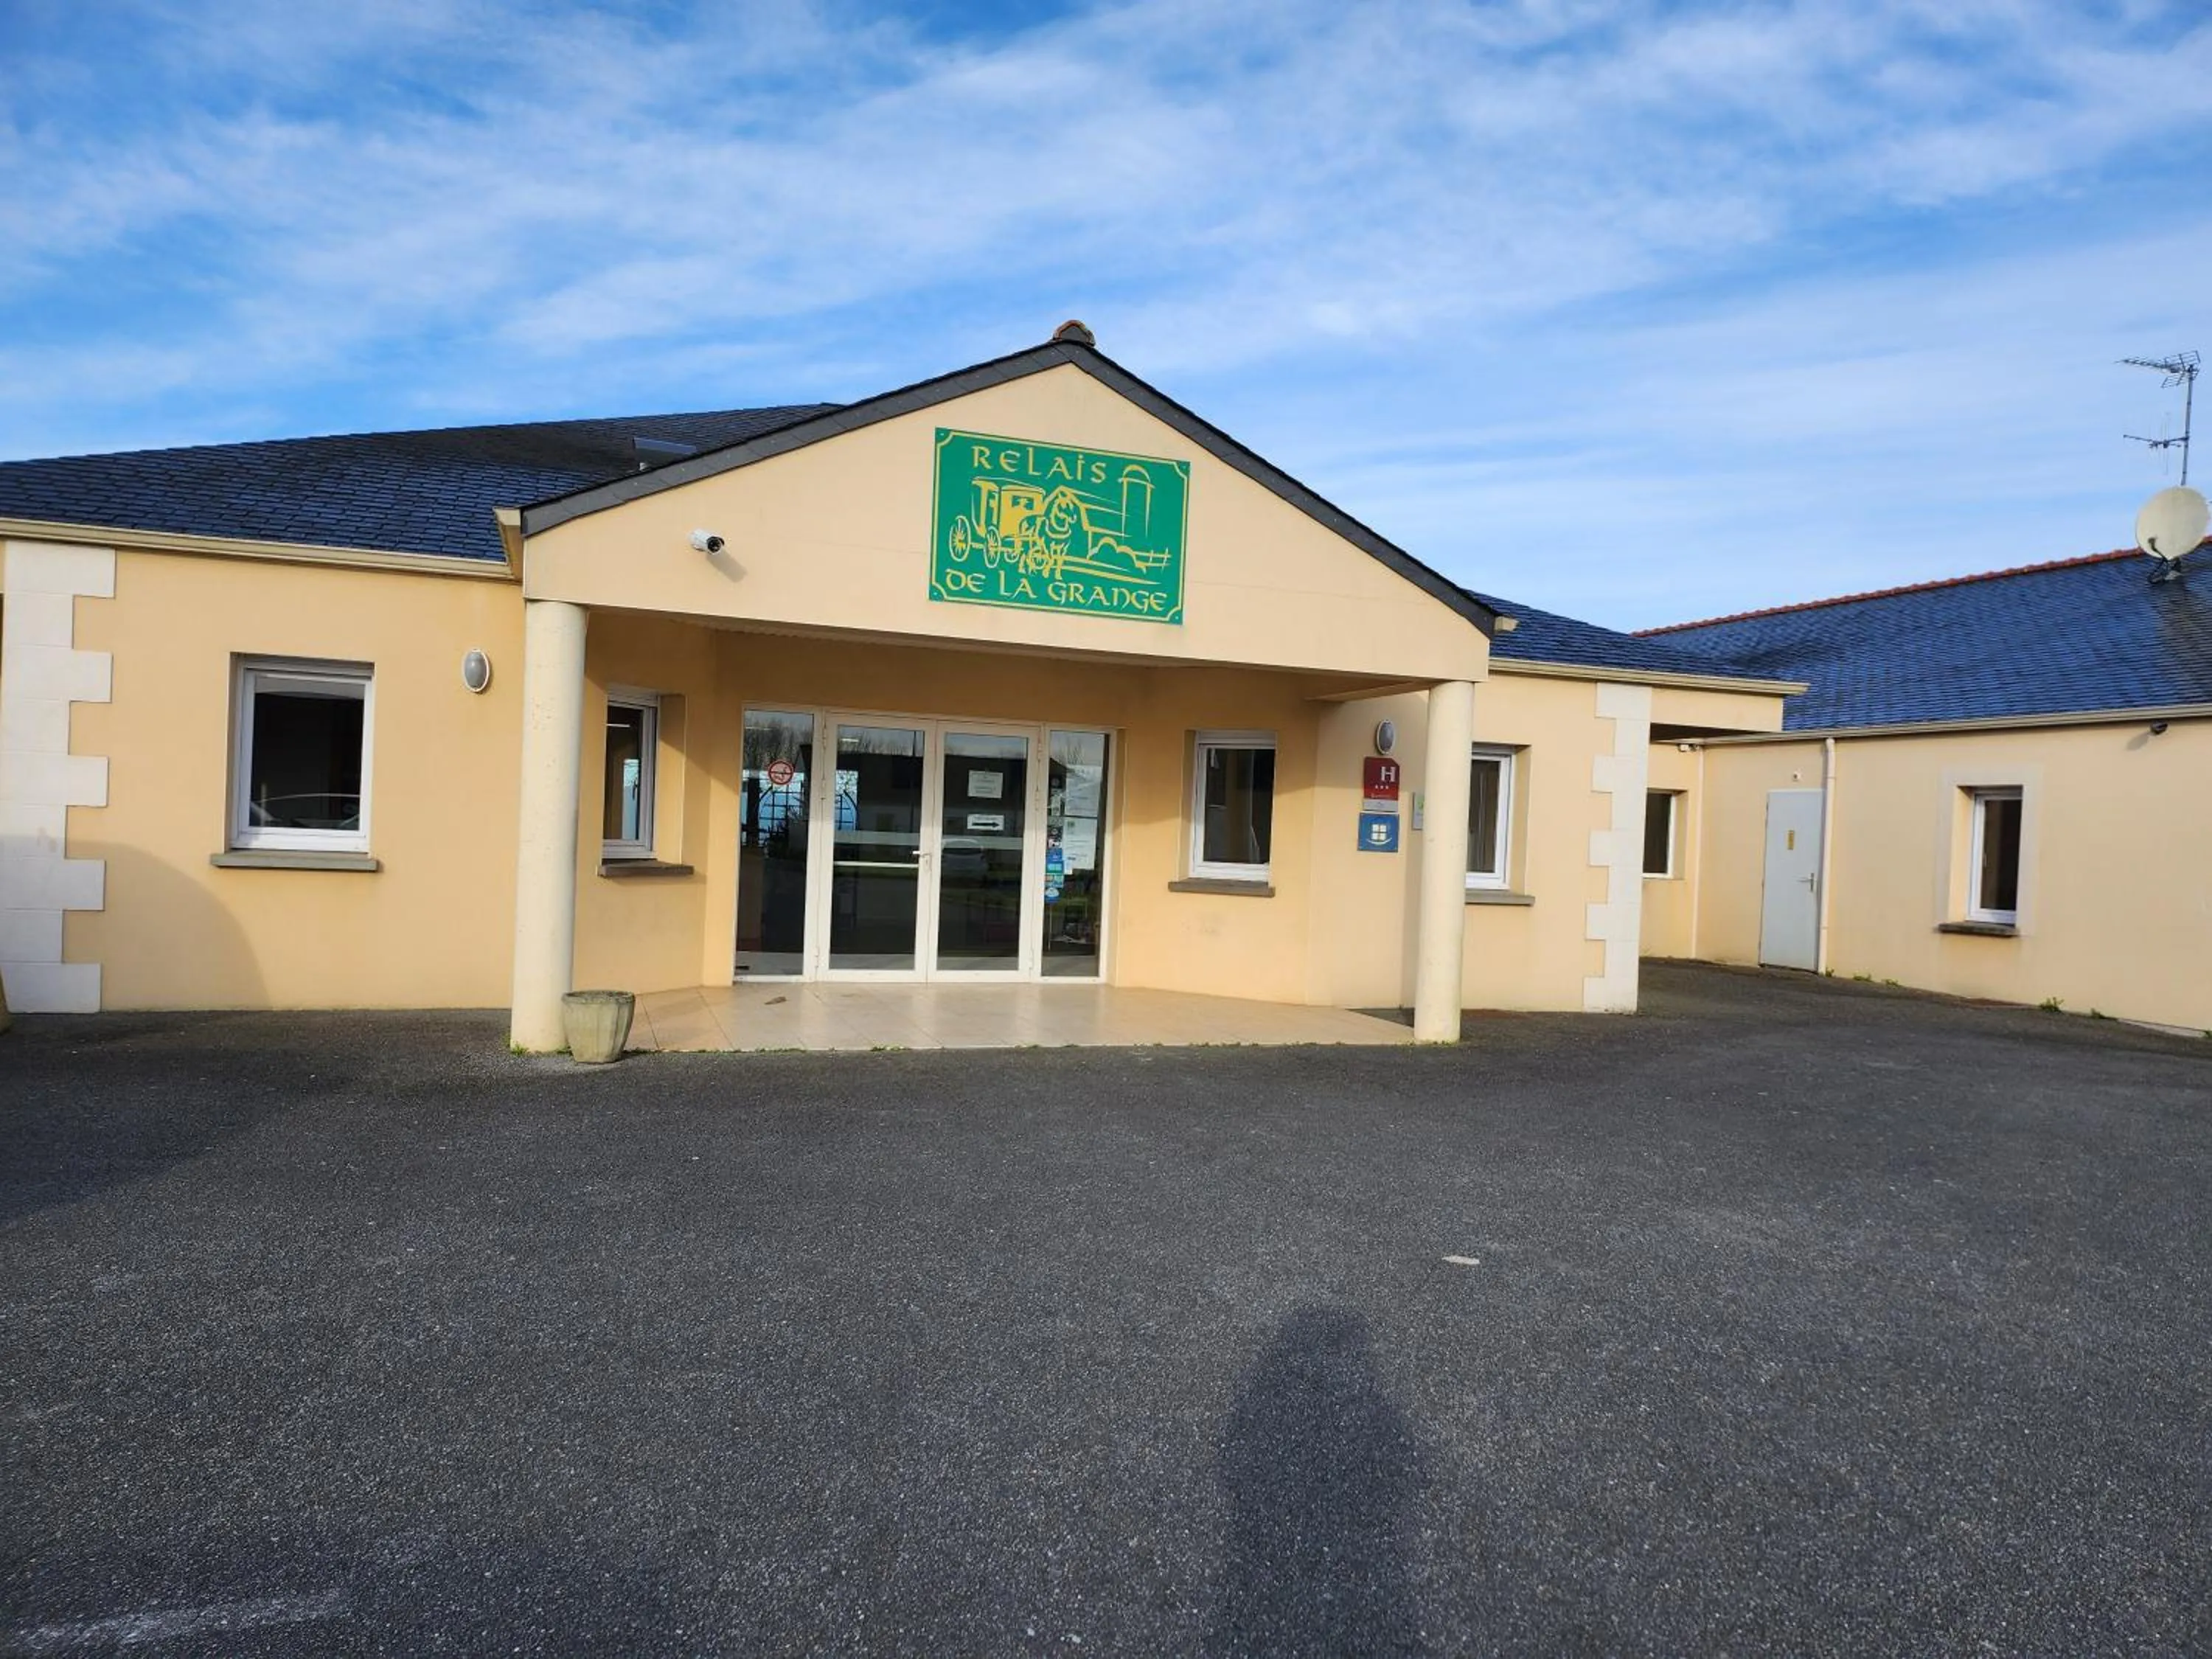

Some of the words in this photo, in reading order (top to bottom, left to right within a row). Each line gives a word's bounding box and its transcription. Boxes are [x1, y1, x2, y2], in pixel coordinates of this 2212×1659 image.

[945, 568, 986, 593] DE
[998, 570, 1037, 599] LA
[1047, 581, 1168, 613] GRANGE
[1381, 766, 1396, 782] H
